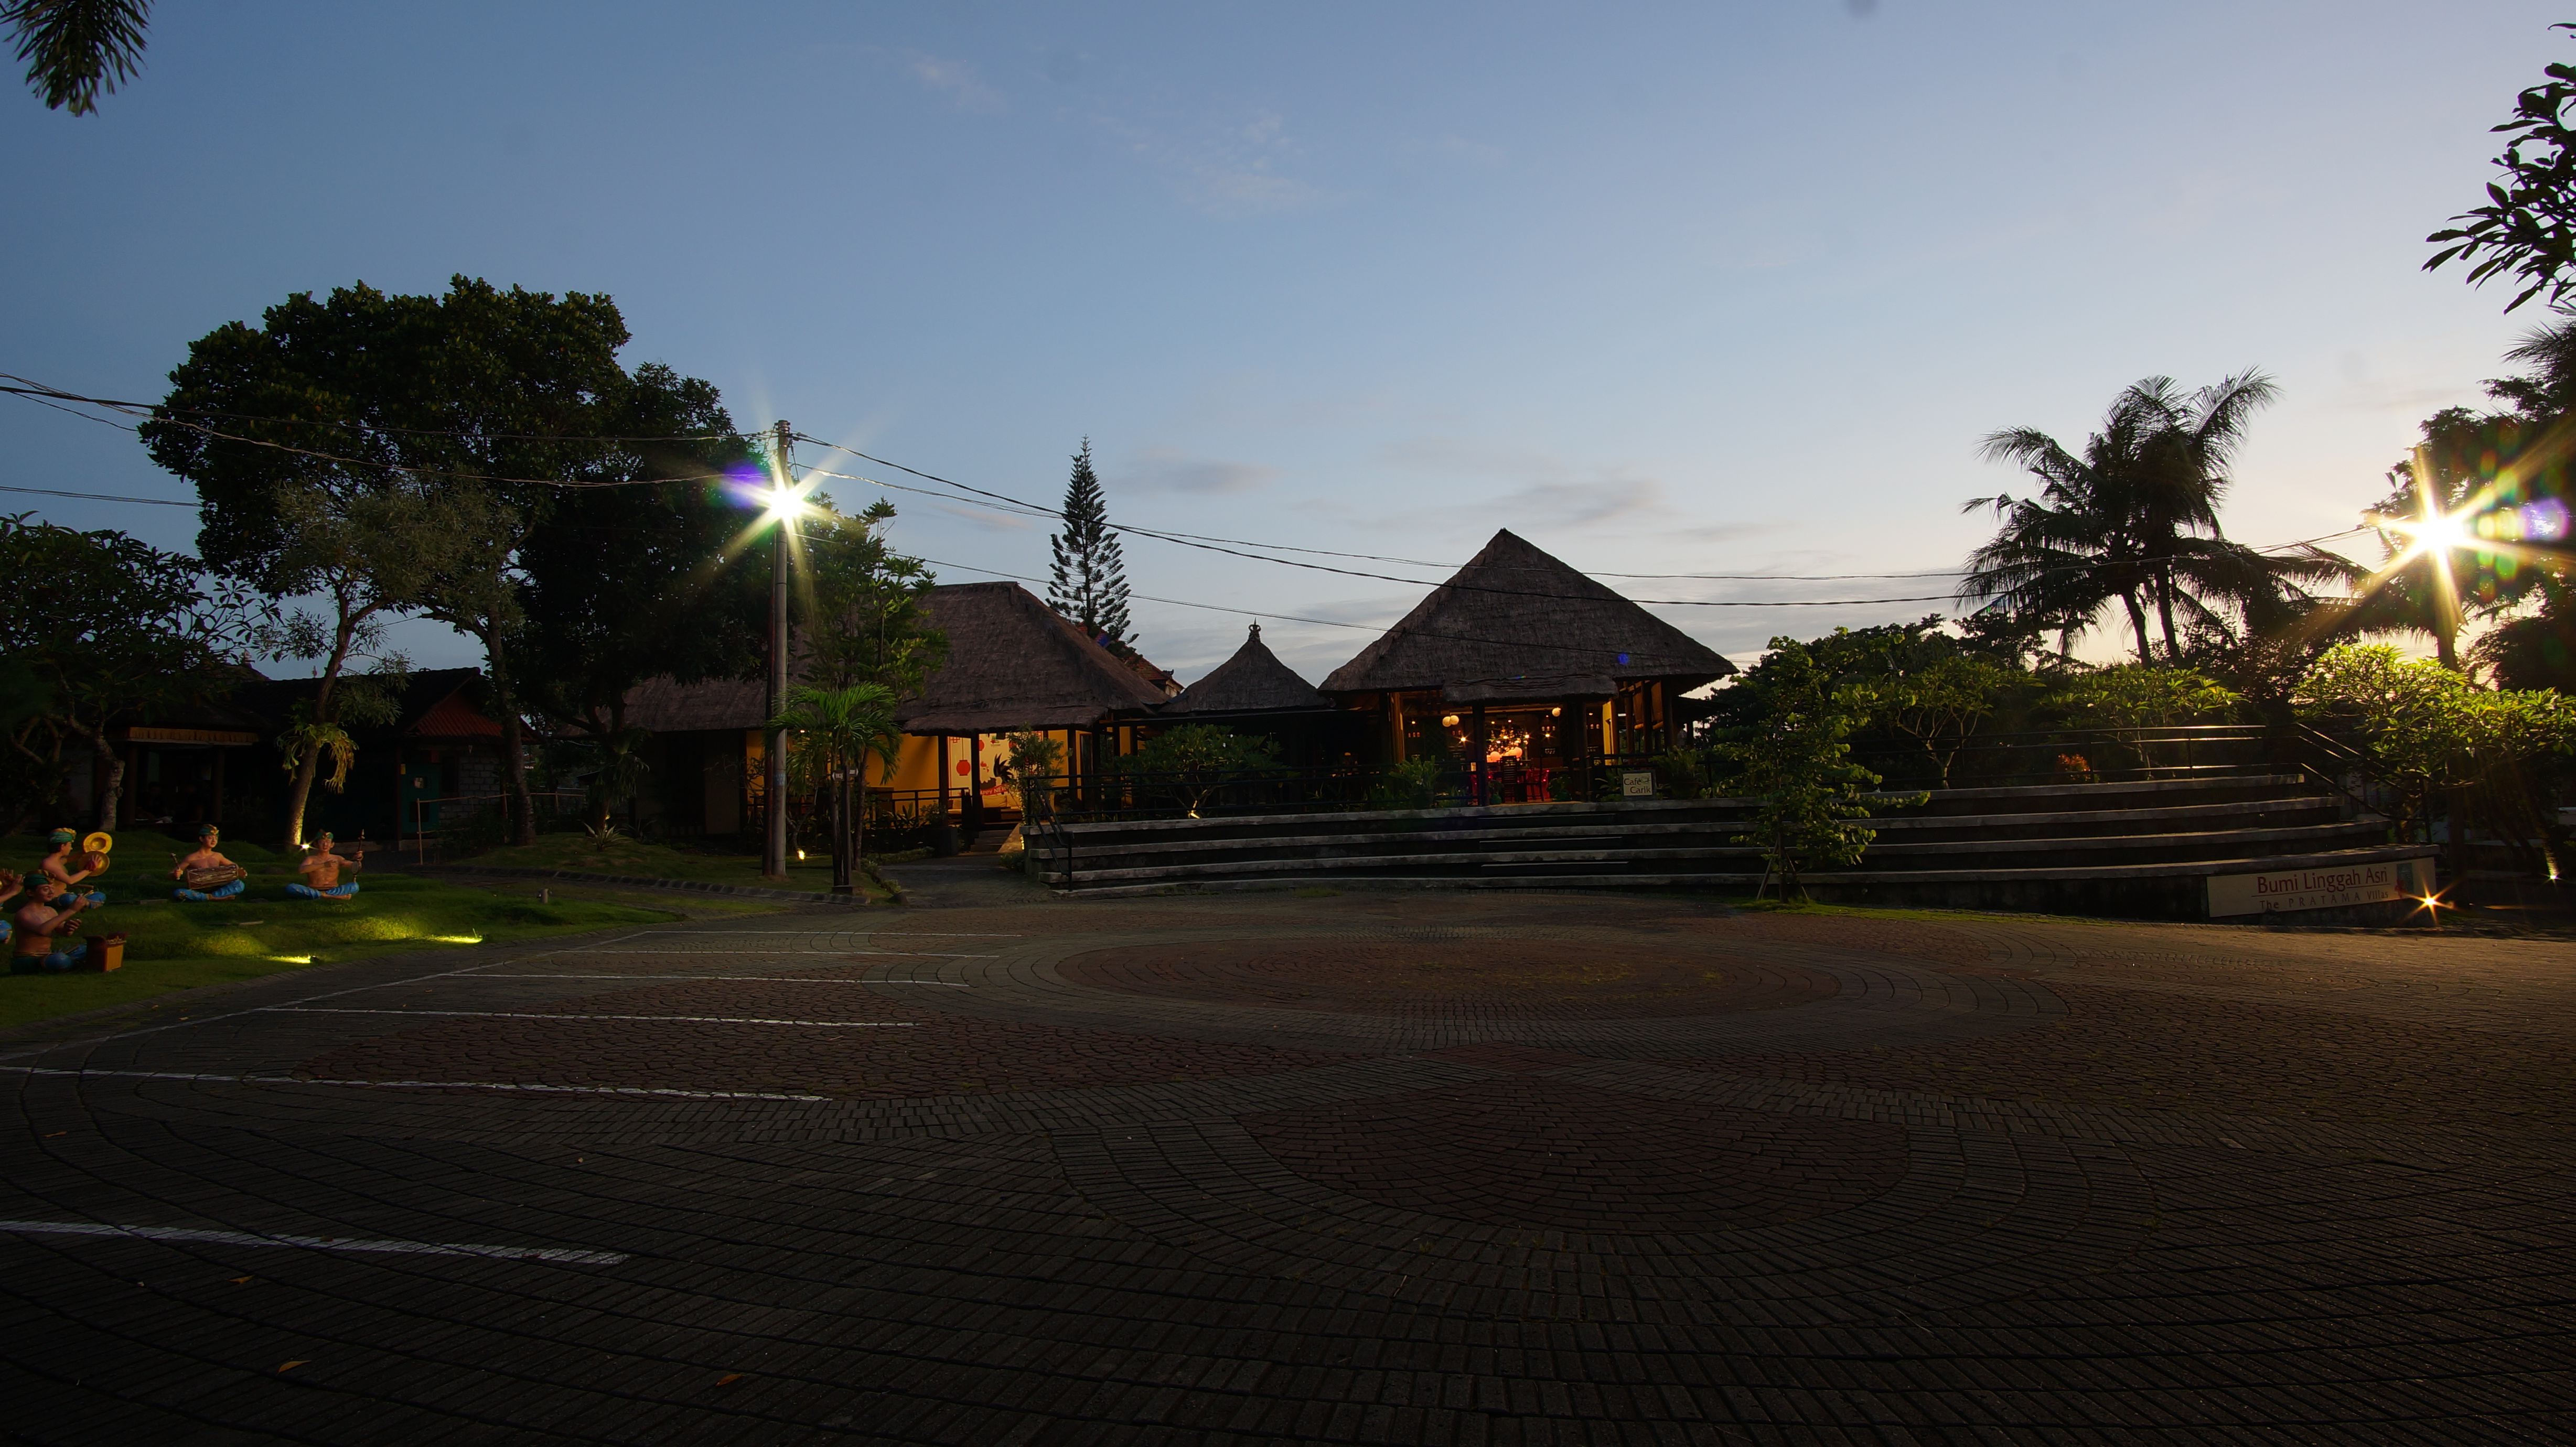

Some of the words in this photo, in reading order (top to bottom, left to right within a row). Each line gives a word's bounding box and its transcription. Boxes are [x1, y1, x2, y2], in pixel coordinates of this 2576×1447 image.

[2257, 874, 2298, 893] Bumi
[2303, 869, 2360, 892] Linggah
[2366, 867, 2387, 884] Asri
[2260, 900, 2279, 910] The
[2289, 892, 2360, 908] PRATAMA
